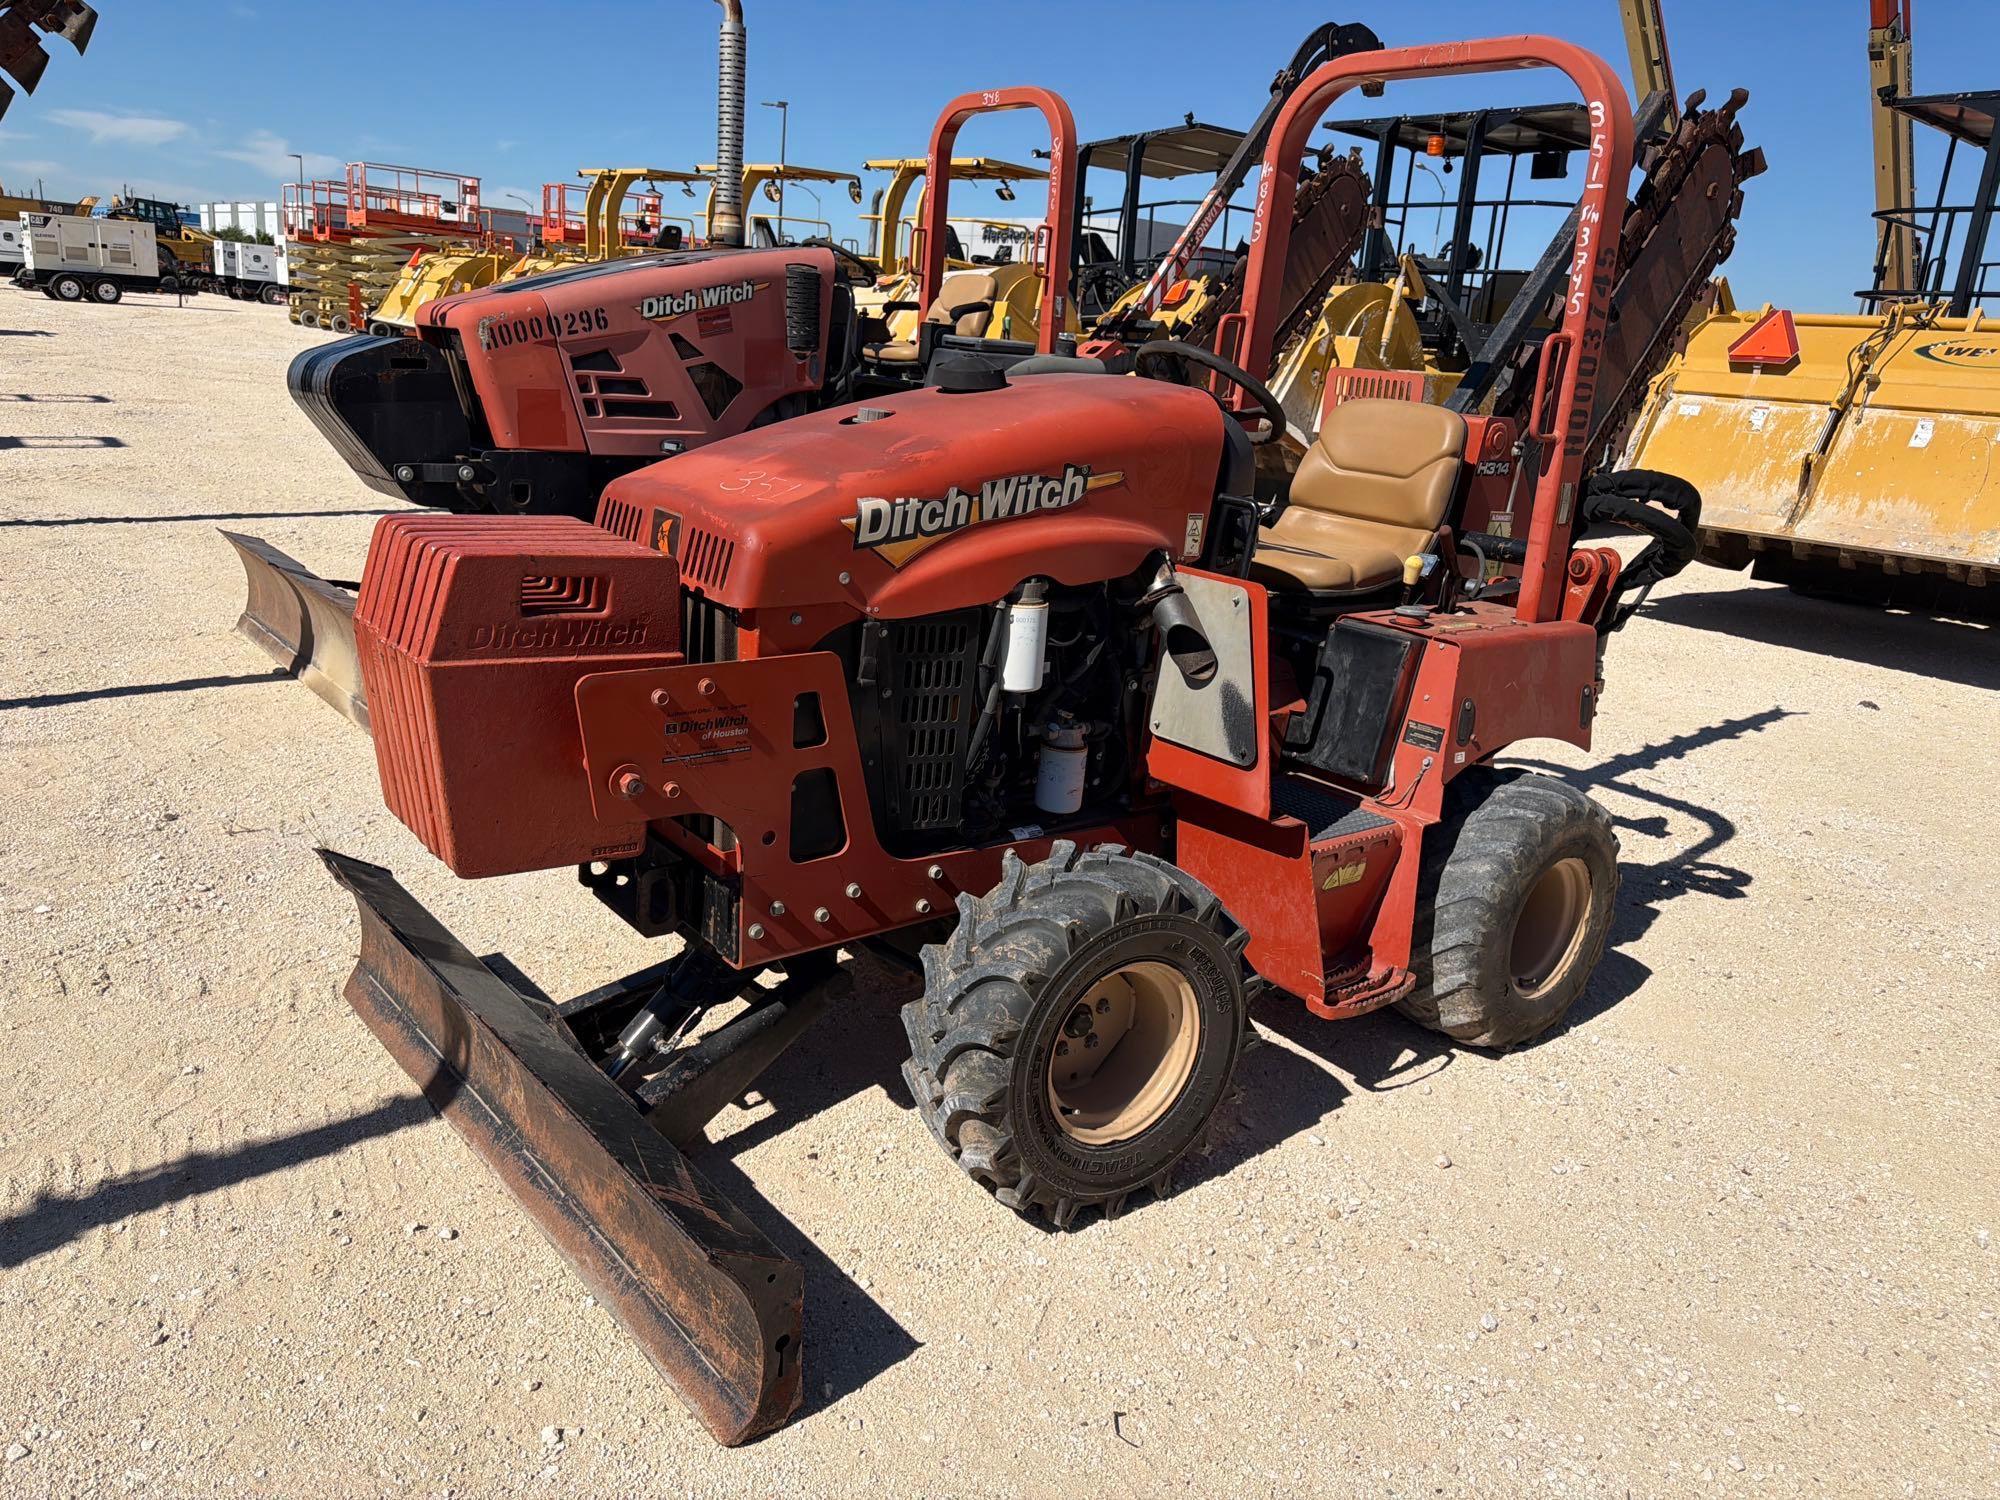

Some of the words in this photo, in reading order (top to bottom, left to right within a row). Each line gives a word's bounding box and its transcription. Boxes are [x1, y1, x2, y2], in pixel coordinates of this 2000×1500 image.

[982, 91, 1000, 105] 348
[1589, 100, 1606, 181] 351
[30, 215, 44, 225] CAT
[1251, 181, 1269, 242] 863
[1567, 226, 1592, 315] 3745
[642, 292, 698, 319] Ditch
[701, 280, 753, 308] Witch
[1477, 462, 1510, 475] H314
[857, 487, 969, 544] Ditch
[982, 467, 1086, 519] Witch
[470, 621, 560, 650] Ditch
[564, 618, 649, 647] Witch
[679, 718, 713, 734] Ditch
[714, 714, 749, 729] Witch
[702, 731, 713, 740] of
[713, 727, 749, 739] Houston
